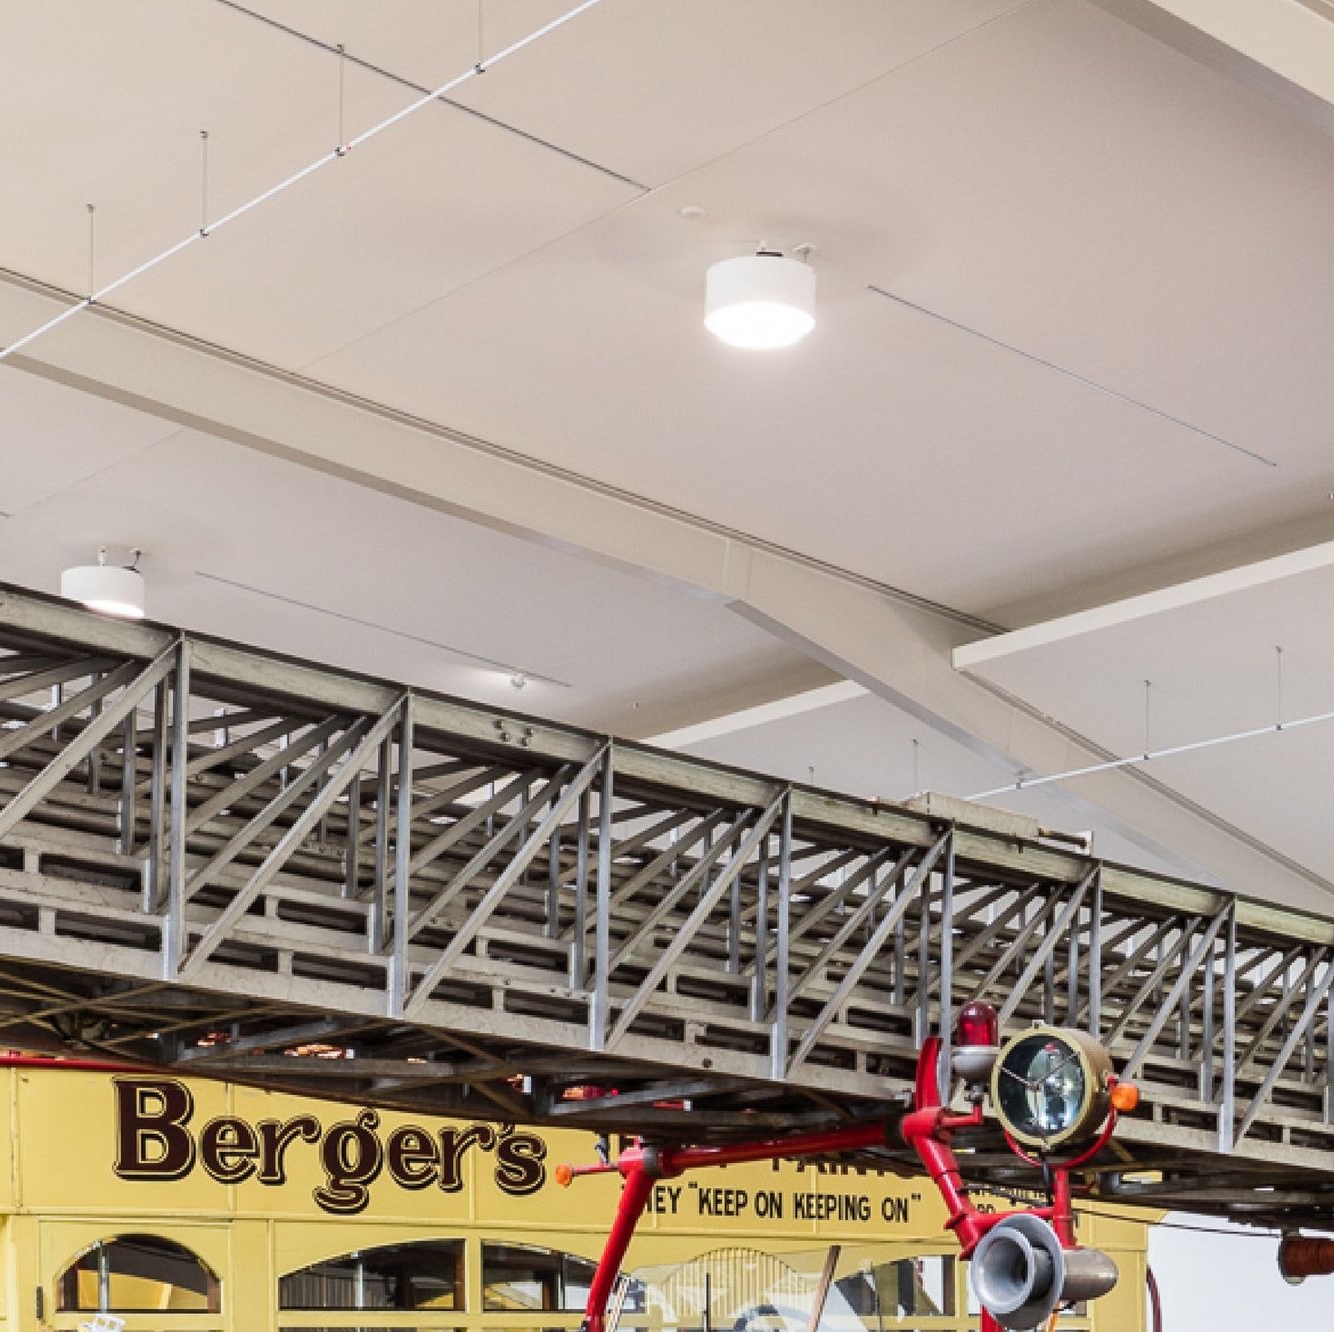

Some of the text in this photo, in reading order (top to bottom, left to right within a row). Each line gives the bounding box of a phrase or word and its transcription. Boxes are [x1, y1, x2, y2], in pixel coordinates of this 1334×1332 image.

[112, 1074, 547, 1214] Berger's
[754, 1190, 783, 1219] ON
[794, 1192, 871, 1221] KEEPING
